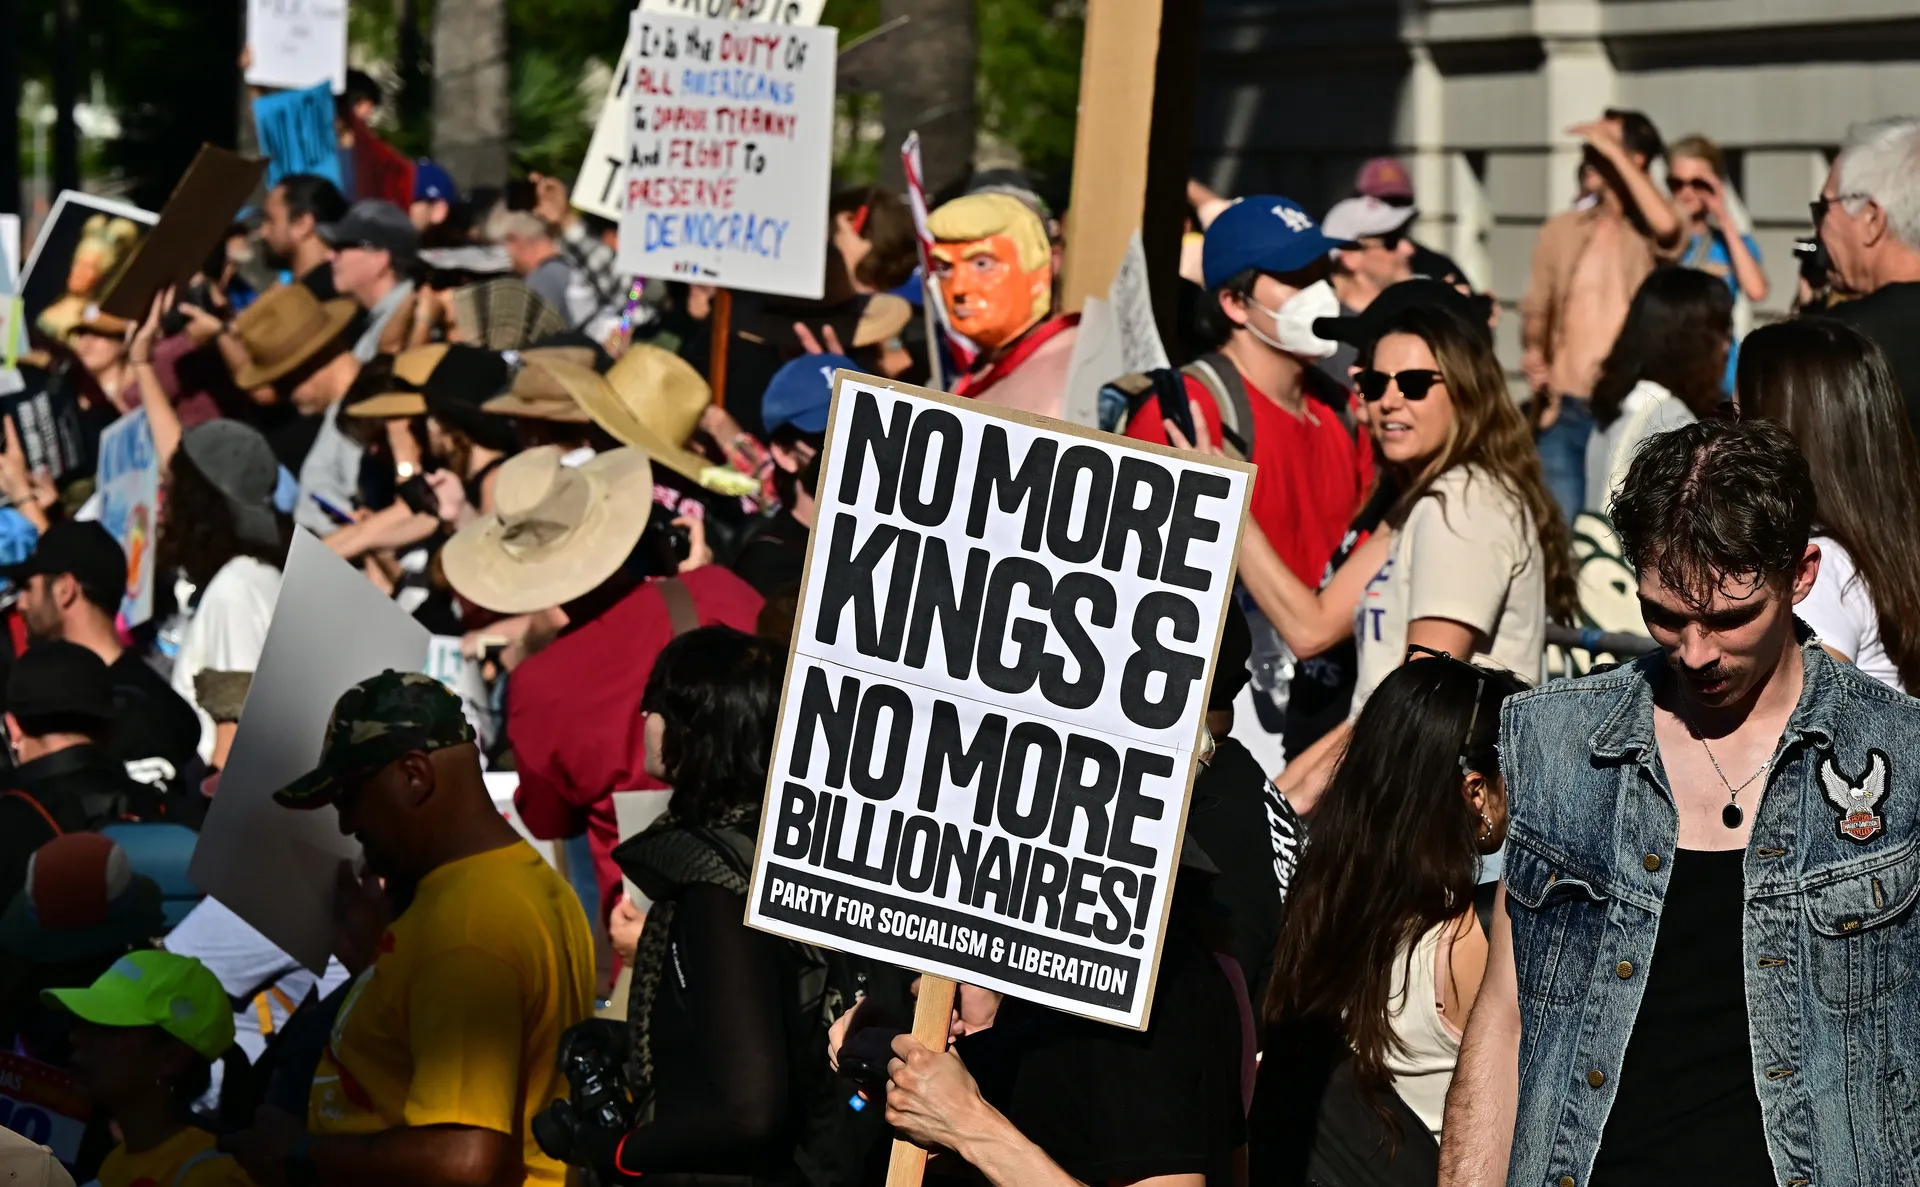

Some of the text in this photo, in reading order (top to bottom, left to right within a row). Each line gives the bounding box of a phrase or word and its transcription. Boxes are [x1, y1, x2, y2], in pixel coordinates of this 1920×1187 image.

[720, 32, 781, 70] DUTY
[634, 67, 672, 95] ALL
[683, 69, 794, 104] AMERICANS
[652, 106, 707, 133] OPPOSE
[716, 106, 798, 139] TYRANNY
[668, 138, 739, 169] FIGHT
[627, 176, 738, 211] PRESERVE
[645, 212, 790, 259] DEMOCRACY
[1271, 205, 1313, 233] LA
[838, 391, 963, 526] NO
[966, 424, 1230, 591] MORE
[815, 513, 1205, 729] KINGS &
[789, 666, 1174, 868] NO MORE
[773, 781, 1156, 950] BILLIONAIRES!
[770, 878, 1128, 995] PARTY FOR SOCIALISM & LIBERATION
